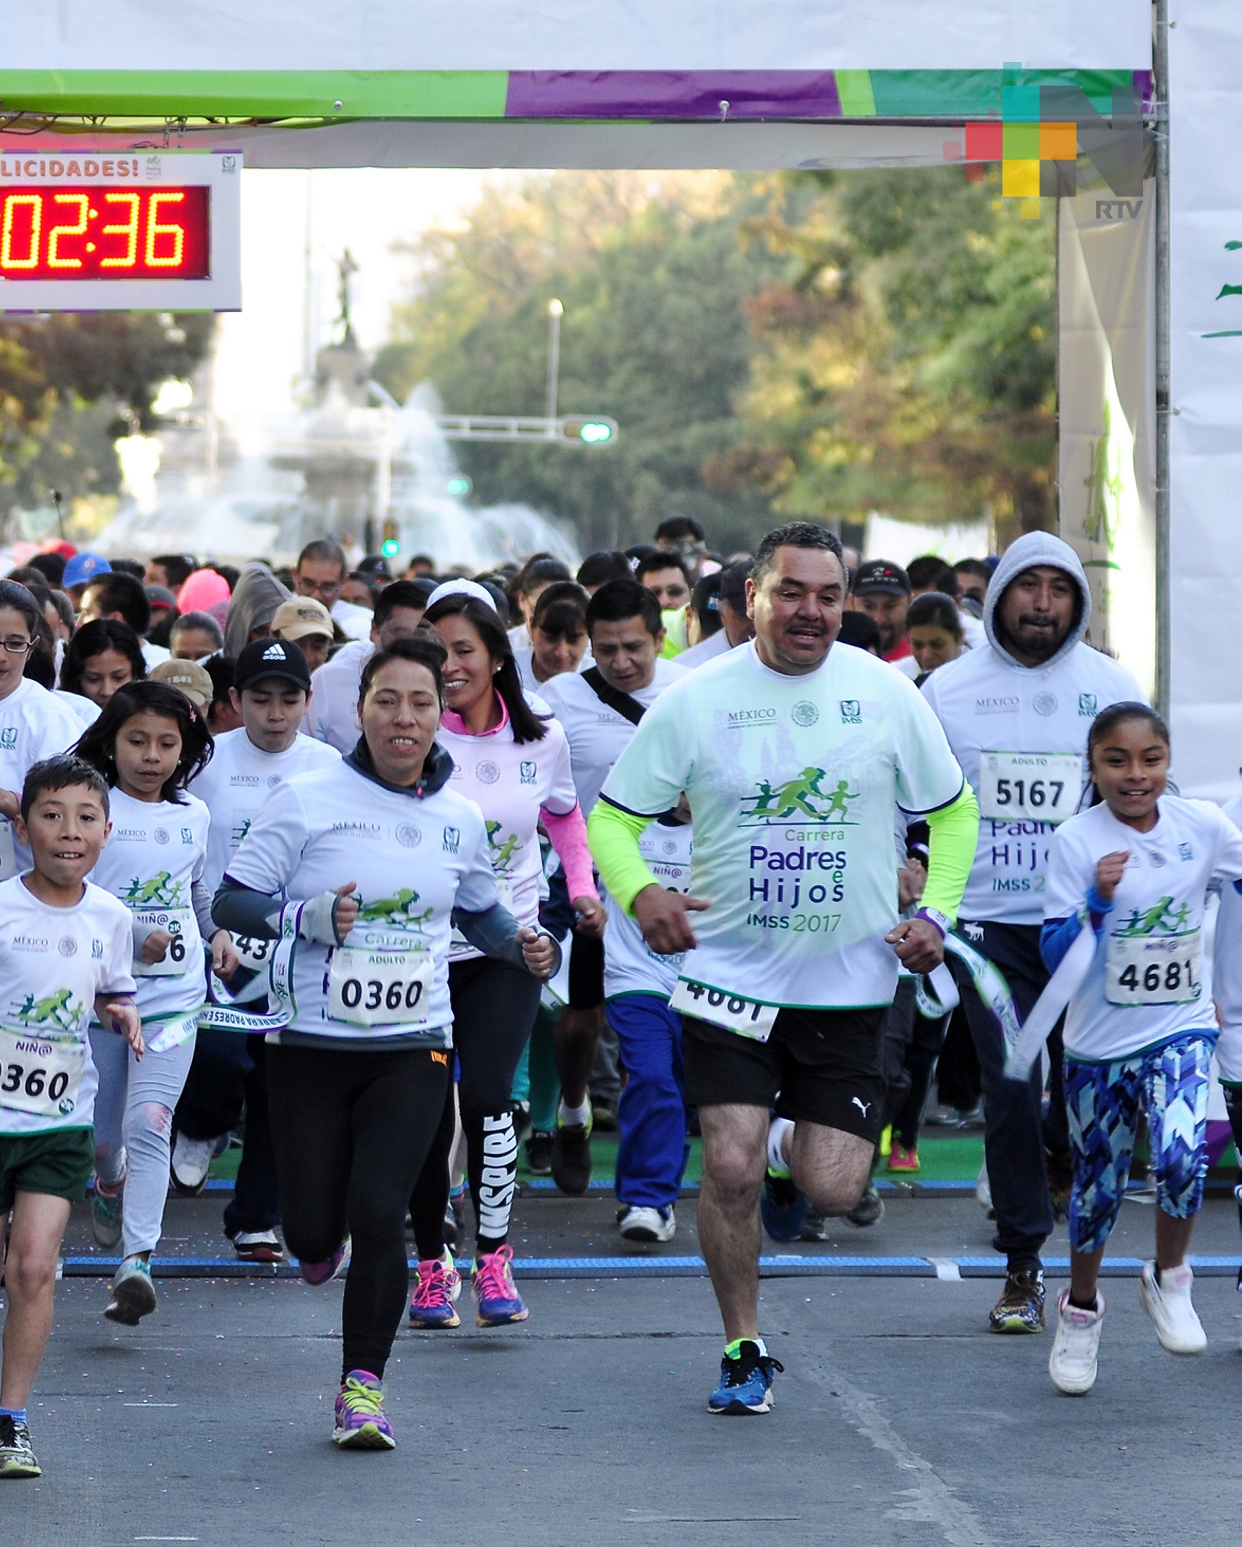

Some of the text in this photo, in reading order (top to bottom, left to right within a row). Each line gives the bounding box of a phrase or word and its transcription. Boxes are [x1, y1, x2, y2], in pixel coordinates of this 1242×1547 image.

[975, 697, 1019, 708] MÉXICO
[728, 708, 776, 721] MÉXICO
[842, 717, 863, 725] IMSS
[1011, 757, 1047, 766] ADULTO
[230, 774, 259, 782] MÉXICO
[996, 779, 1064, 808] 5167
[118, 828, 146, 837] MÉXICO
[785, 829, 845, 842] Carrera
[750, 845, 846, 871] Padres
[654, 866, 682, 878] NIÑ@
[832, 870, 844, 883] e
[992, 877, 1030, 892] IMSS
[749, 878, 844, 908] Hijos
[169, 924, 180, 932] 2K
[747, 912, 842, 932] IMSS 2017
[13, 935, 49, 947] MÉXICO
[365, 932, 422, 949] Carrera
[368, 955, 406, 965] ADULTO
[1119, 959, 1193, 992] 4681
[341, 978, 423, 1010] 0360
[215, 1011, 246, 1025] PADRES
[15, 1040, 52, 1058] NIÑ@
[478, 1112, 518, 1239] INSPIRE
